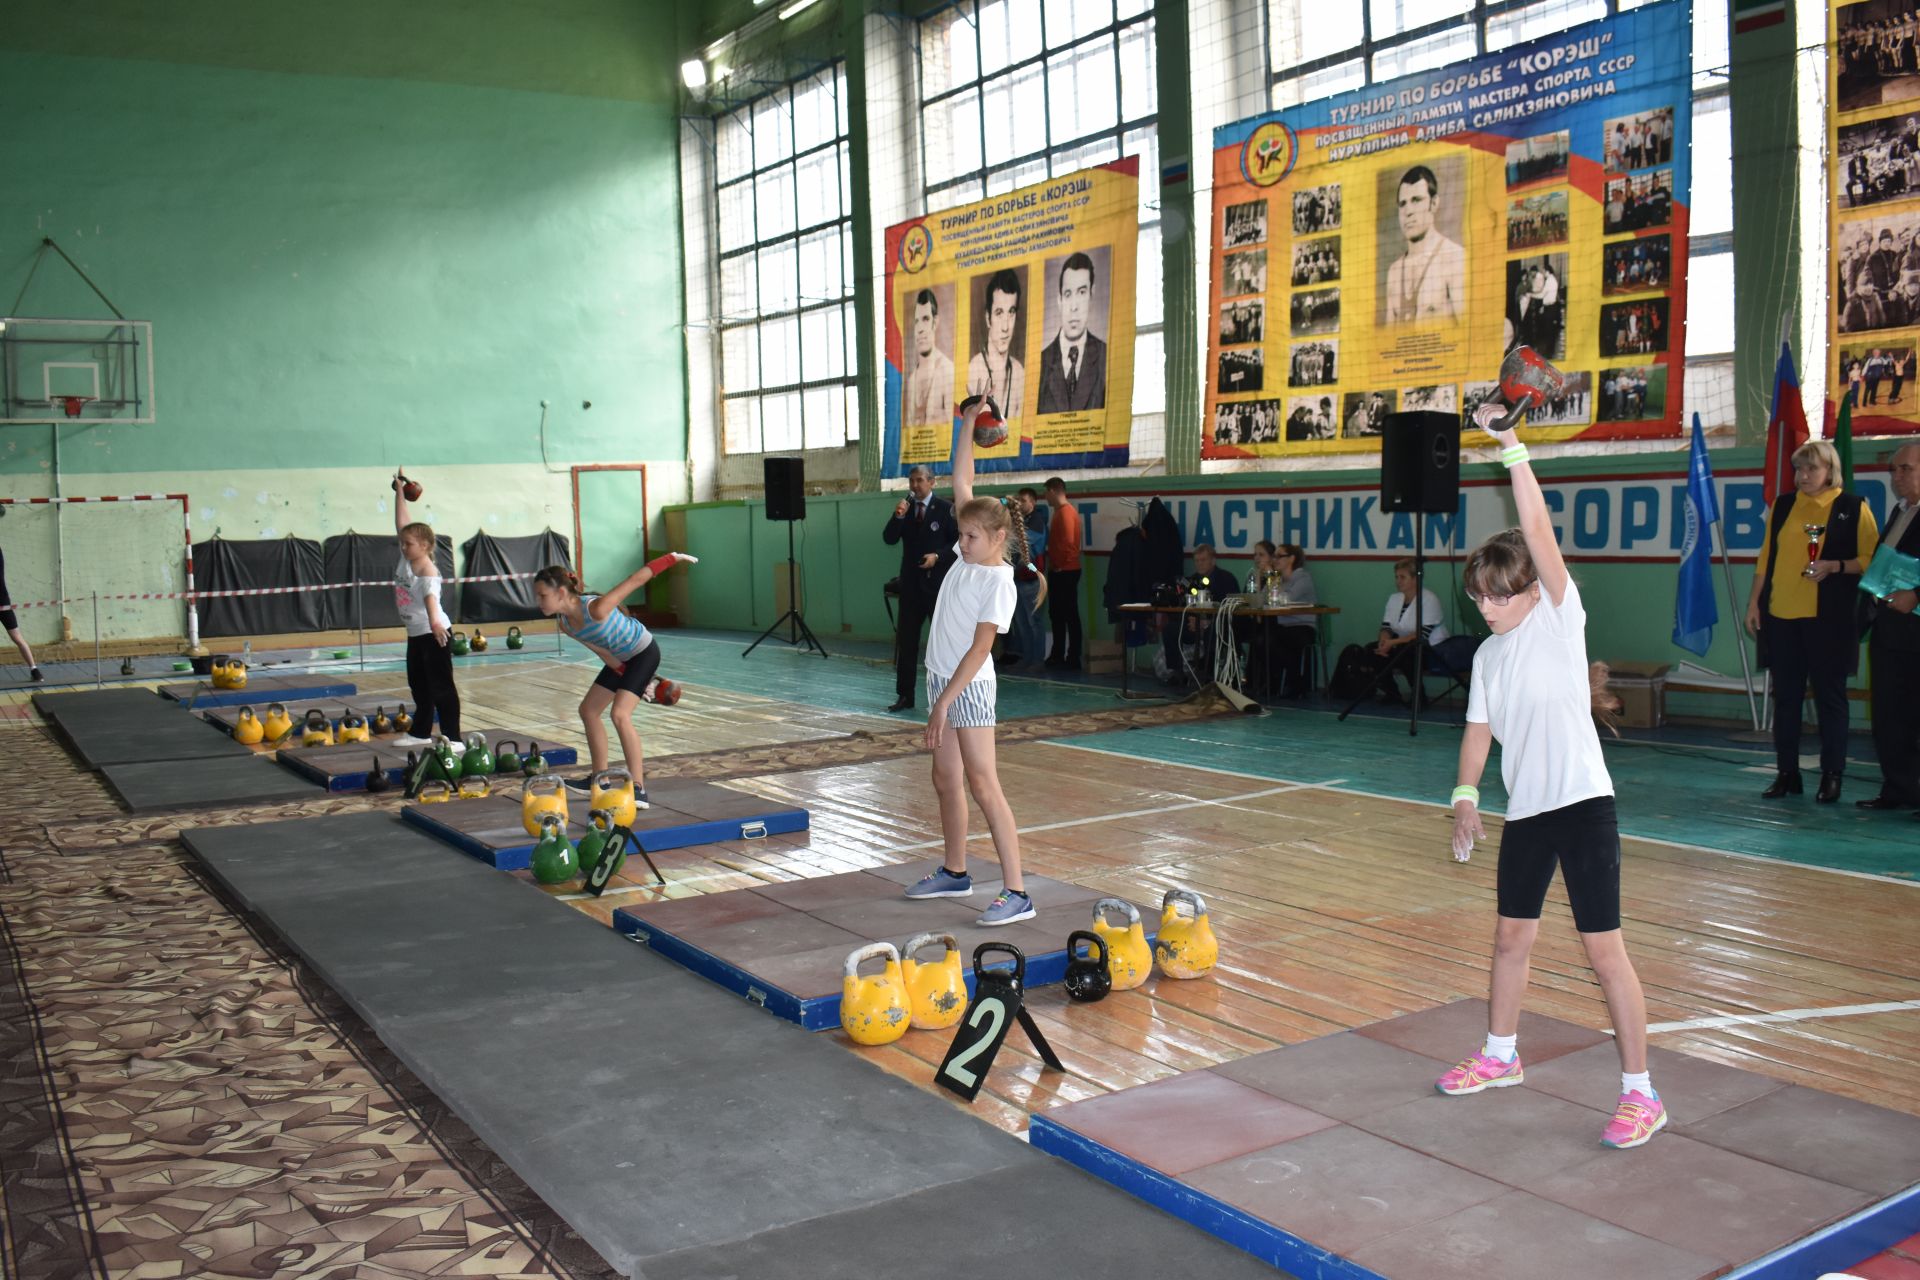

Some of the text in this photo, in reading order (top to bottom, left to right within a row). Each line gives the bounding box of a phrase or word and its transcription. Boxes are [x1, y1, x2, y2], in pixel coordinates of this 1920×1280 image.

[1315, 55, 1636, 148] ПОСВЯЩЕННЫЙ ПАМЯТИ МАСТЕРА СПОРТА СССР
[1328, 79, 1616, 163] НУРУЛЛИНА АДИБА САЛИХЗЯНОВИЧА
[1329, 95, 1396, 125] ТУРНИР
[1400, 86, 1425, 108] ПО
[1430, 64, 1503, 99] БОРЬБЕ
[941, 210, 978, 230] ТУРНИР
[980, 205, 995, 220] ПО
[997, 192, 1037, 215] БОРЬБЕ
[444, 757, 455, 769] 3
[482, 754, 490, 766] 1
[559, 848, 570, 865] 1
[591, 833, 624, 887] 3
[943, 996, 1006, 1089] 2
